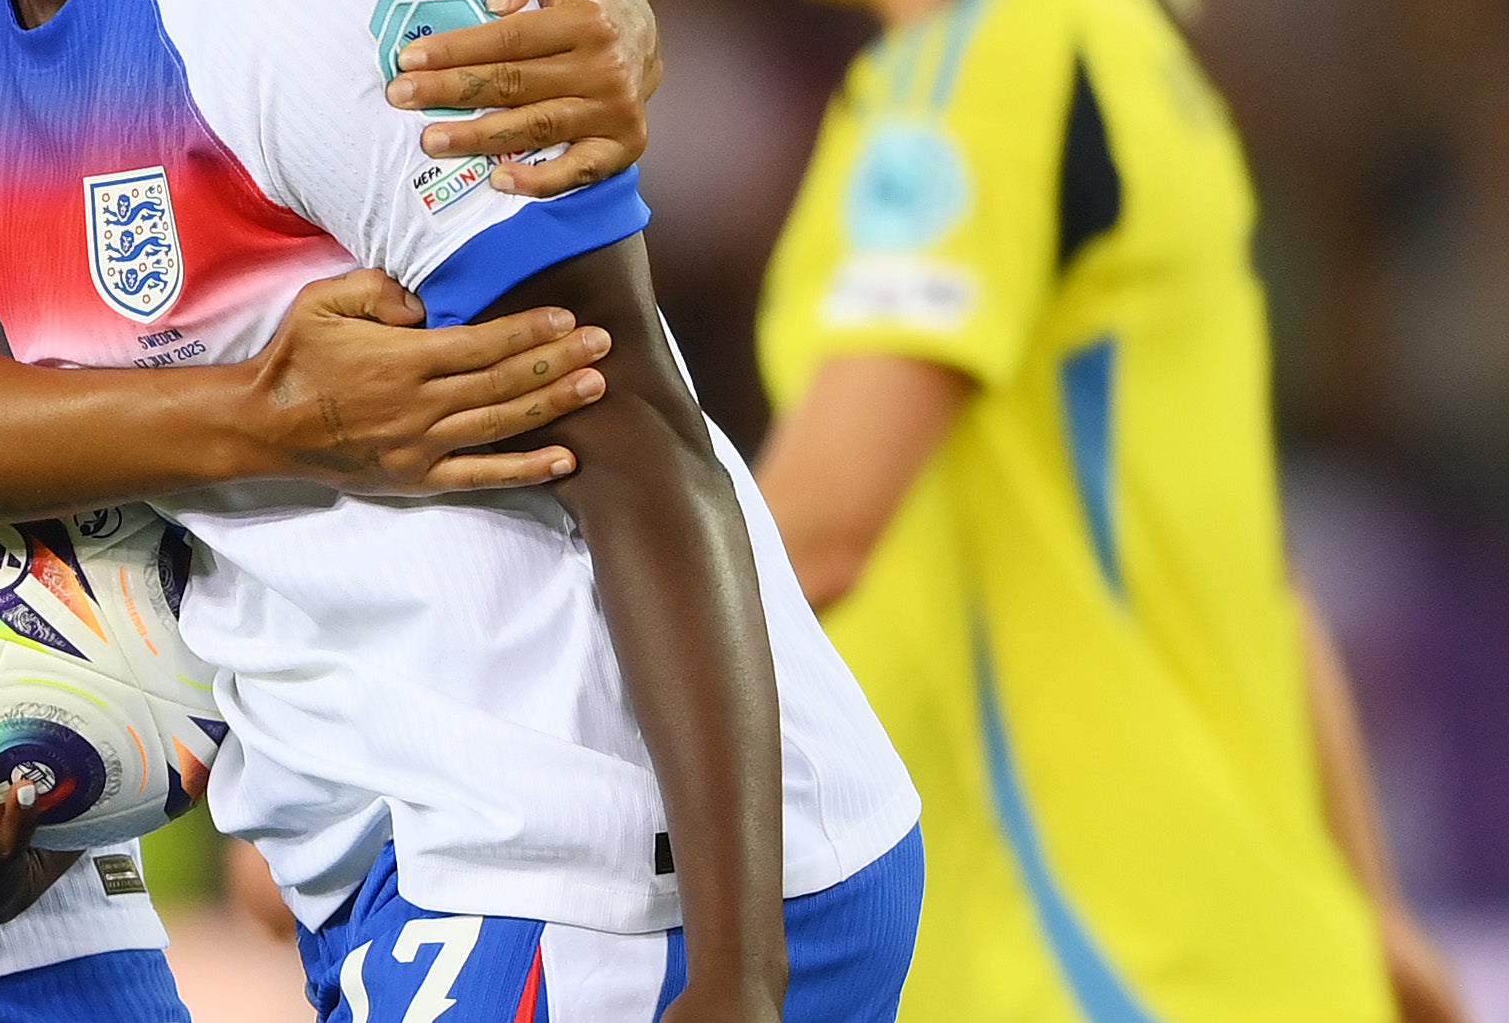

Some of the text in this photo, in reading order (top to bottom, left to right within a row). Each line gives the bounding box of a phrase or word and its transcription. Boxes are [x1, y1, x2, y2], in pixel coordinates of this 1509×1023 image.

[413, 165, 443, 190] UEFA
[137, 327, 184, 351] SWEDEN
[148, 352, 175, 369] JULY
[173, 339, 207, 361] 2025
[339, 915, 484, 1023] 17
